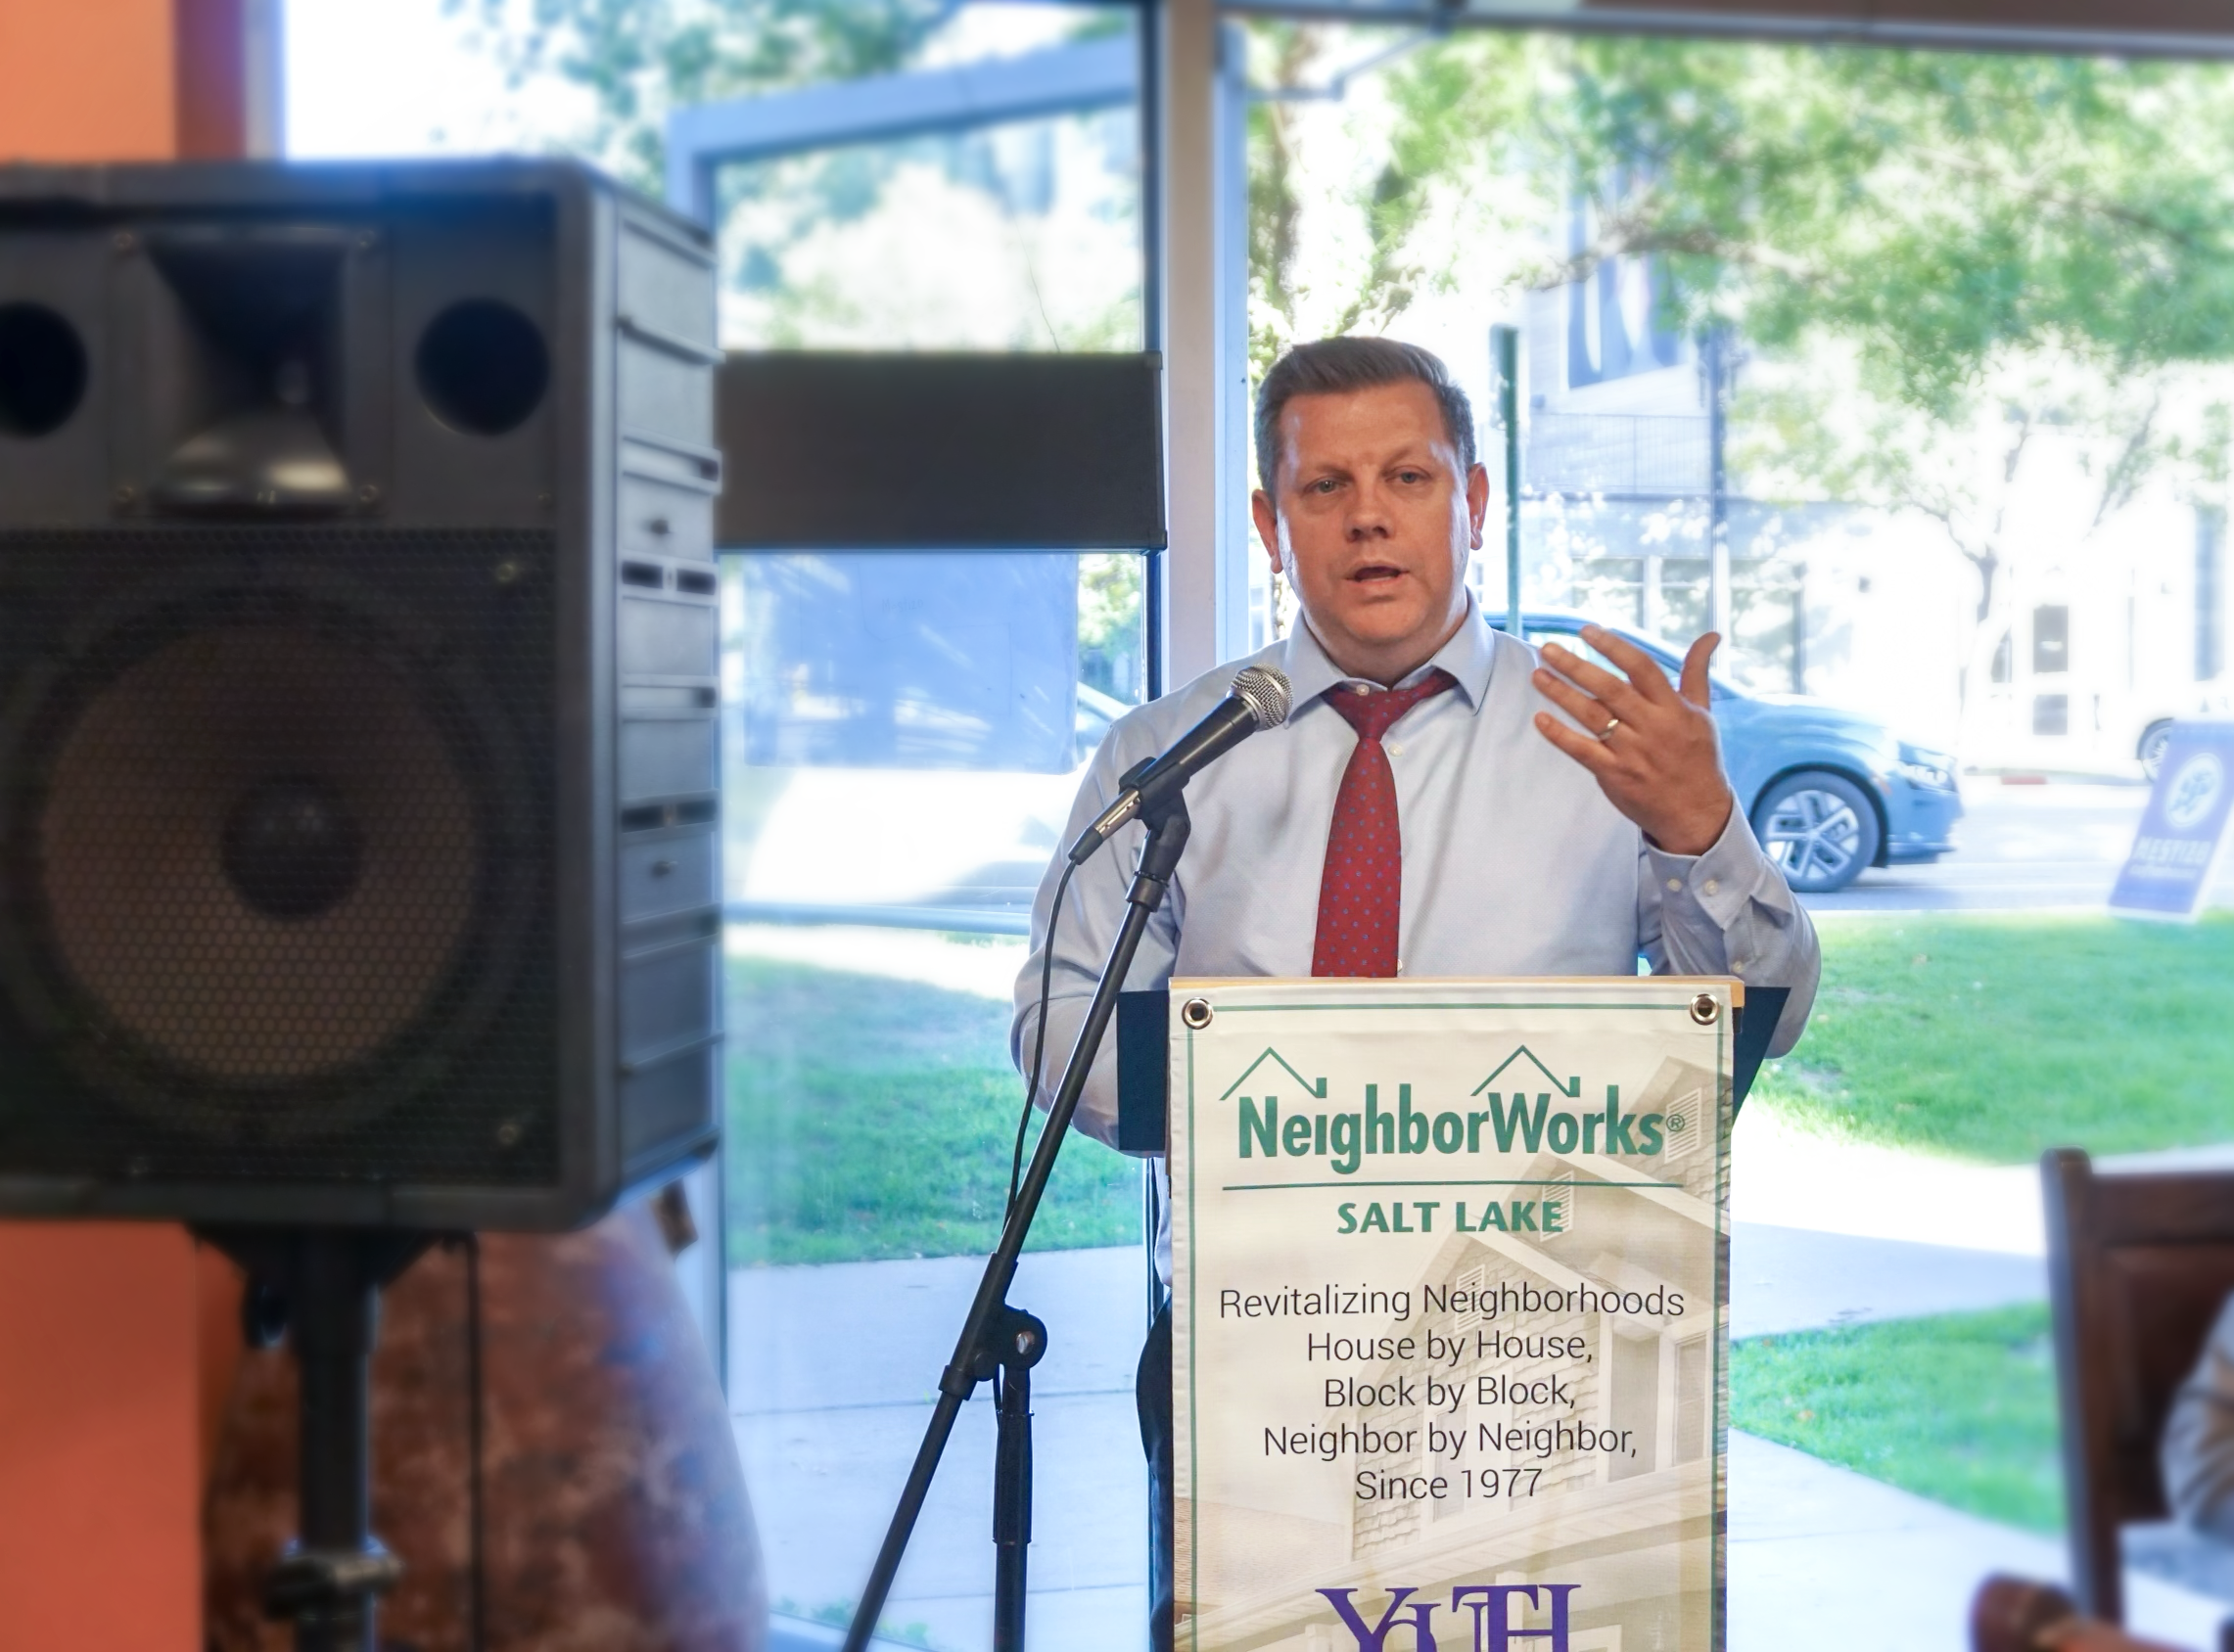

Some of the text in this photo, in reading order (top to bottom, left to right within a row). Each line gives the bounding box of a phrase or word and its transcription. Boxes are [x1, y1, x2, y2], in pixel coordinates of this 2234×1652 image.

[1336, 1201, 1564, 1235] SALT LAKE
[1220, 1281, 1685, 1321] Revitalizing Neighborhoods
[1307, 1328, 1593, 1367] House by House,
[1324, 1374, 1576, 1414] Block by Block,
[1264, 1420, 1637, 1462] Neighbor by Neighbor,
[1354, 1468, 1544, 1500] Since 1977
